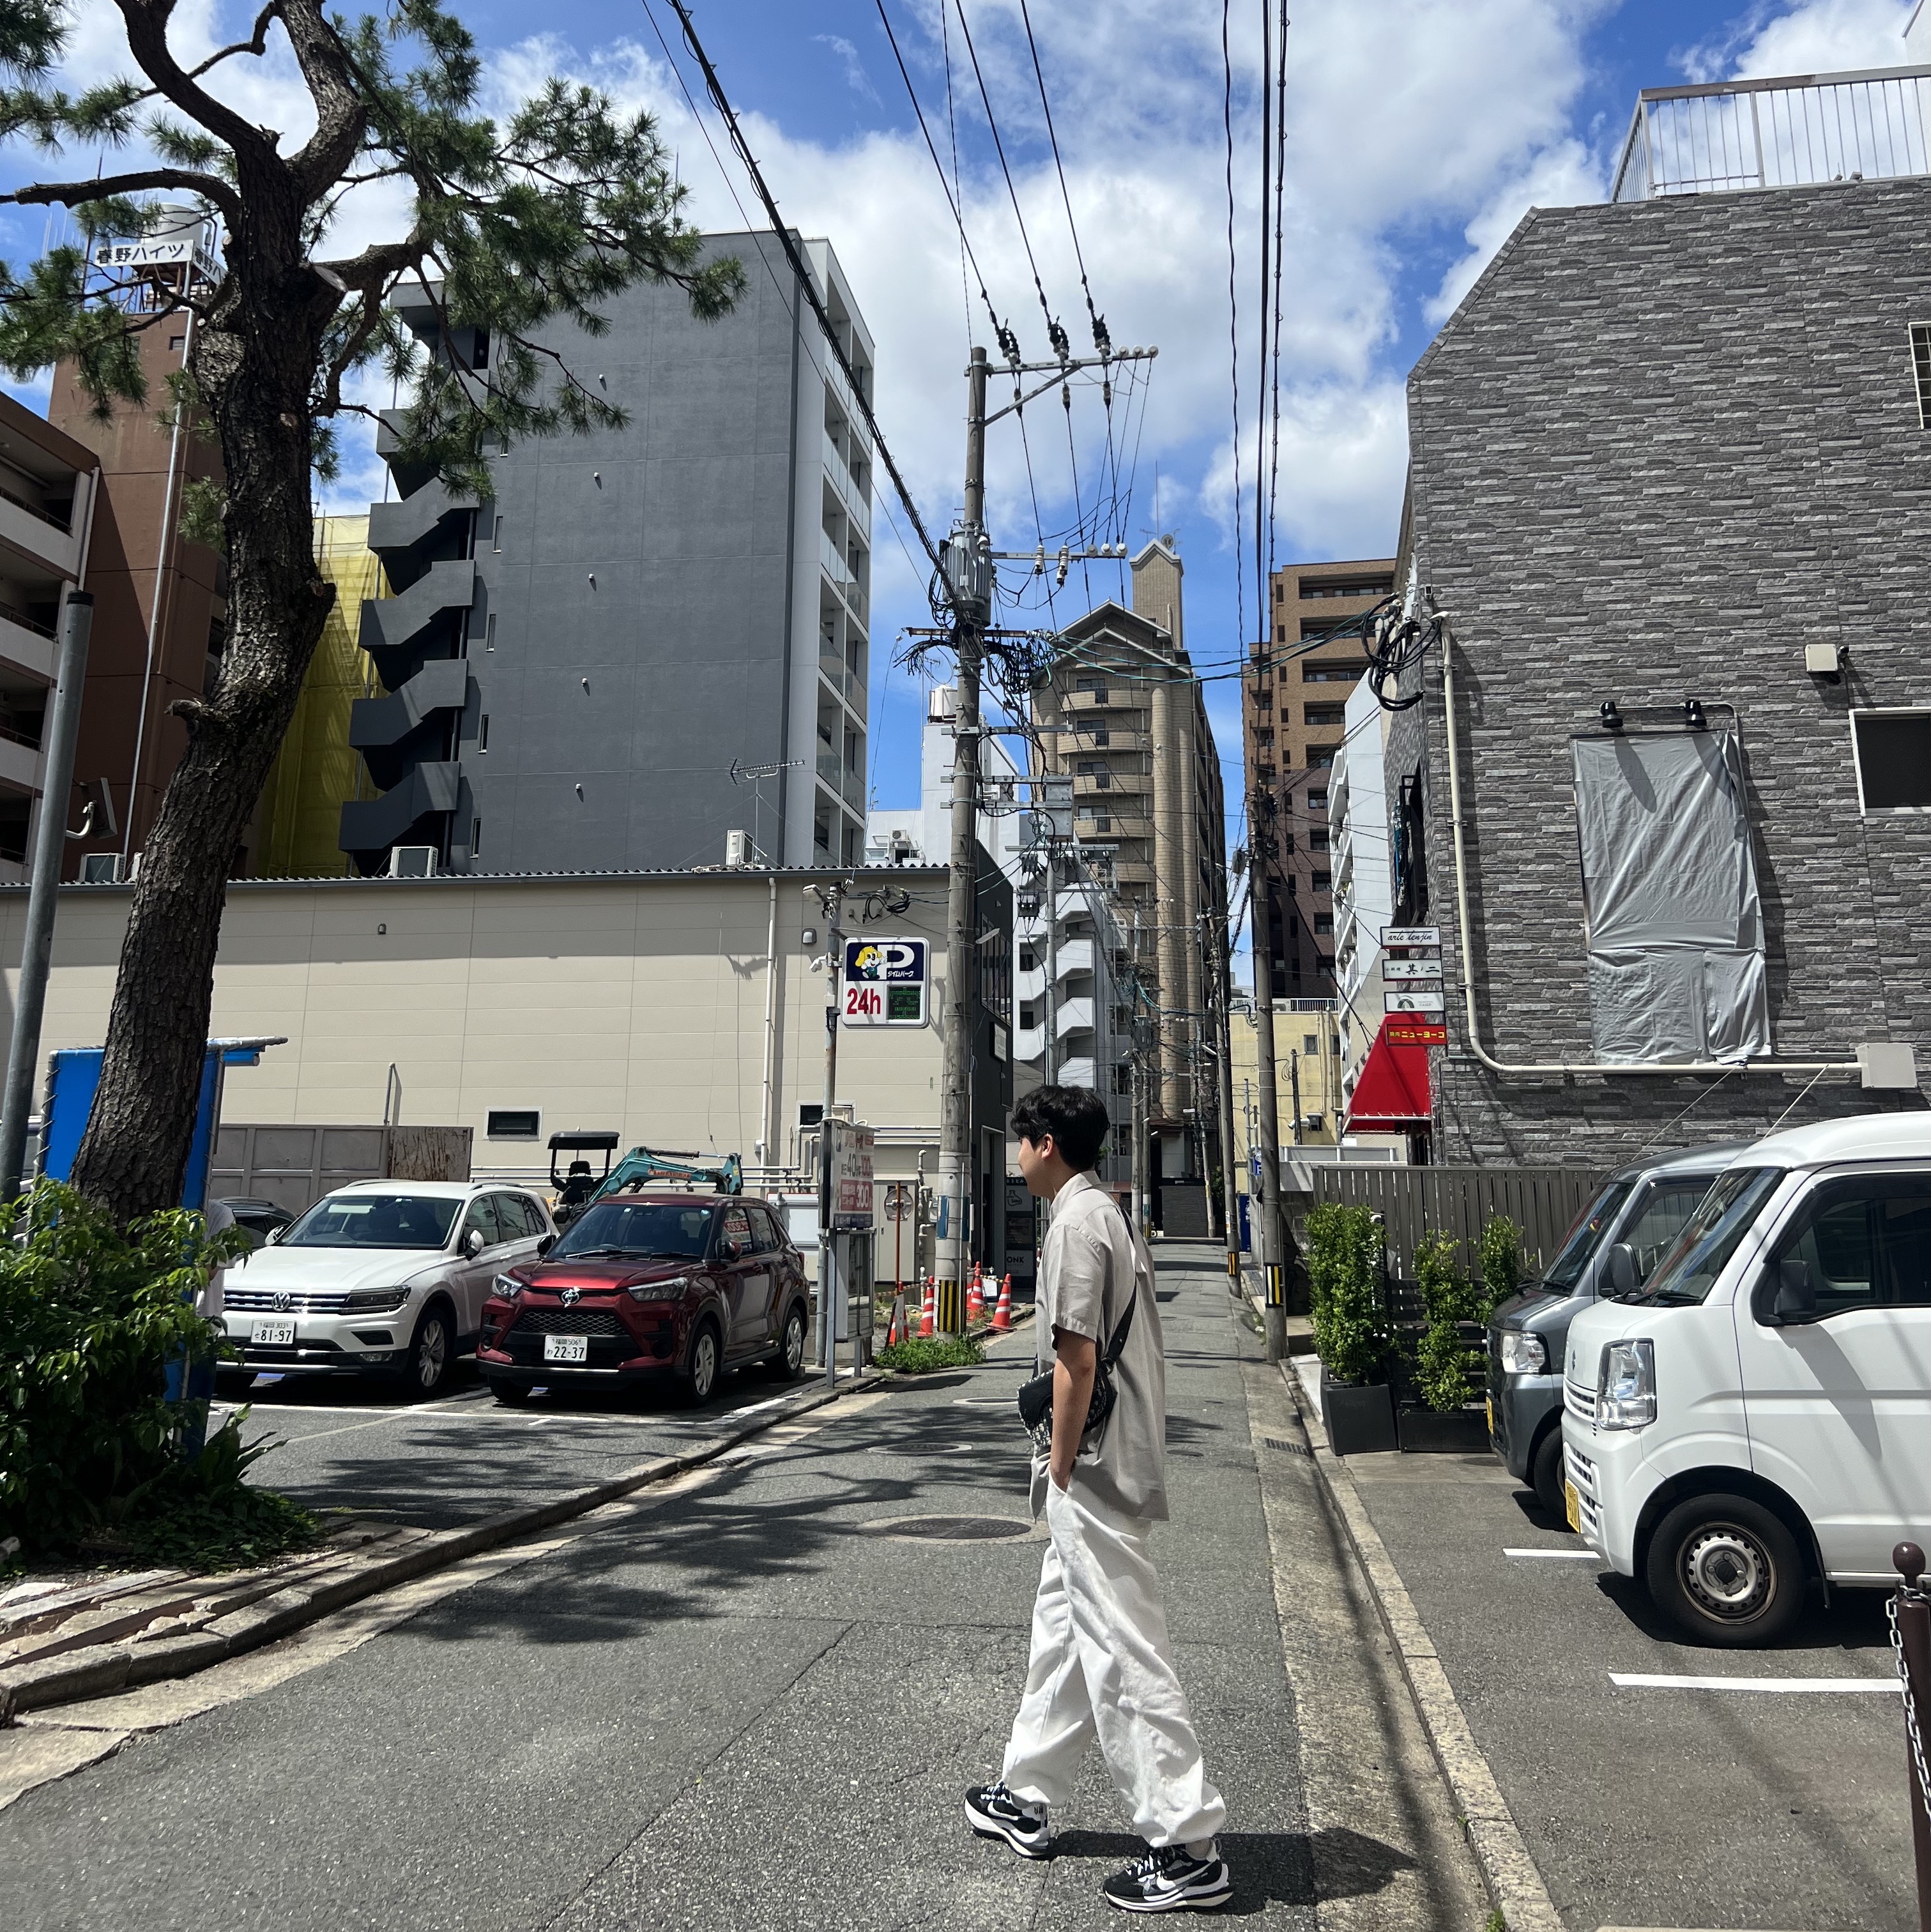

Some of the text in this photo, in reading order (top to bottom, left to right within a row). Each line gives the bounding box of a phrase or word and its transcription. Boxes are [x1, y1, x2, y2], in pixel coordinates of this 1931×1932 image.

[97, 243, 184, 264] 春野ハイツ
[1405, 930, 1432, 943] tenjin
[877, 945, 915, 980] P
[846, 987, 881, 1014] 24h
[261, 1329, 292, 1342] 81-97
[553, 1346, 584, 1359] 22-37
